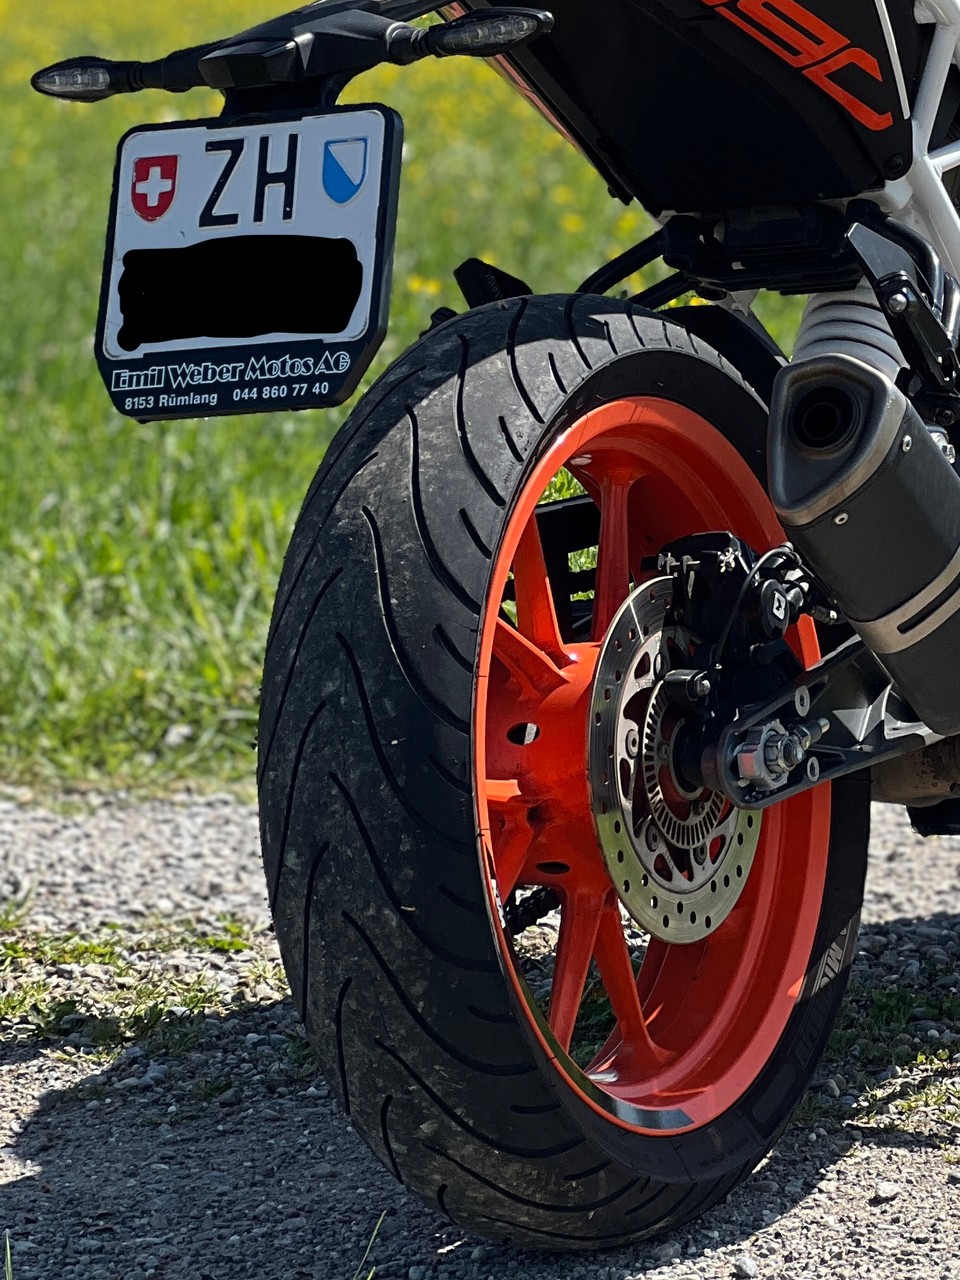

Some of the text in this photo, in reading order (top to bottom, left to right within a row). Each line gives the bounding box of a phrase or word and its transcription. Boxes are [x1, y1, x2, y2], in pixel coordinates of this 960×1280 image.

[199, 133, 299, 228] ZH
[111, 350, 350, 391] Emil Weber Motos AG
[124, 381, 329, 410] 8153 Rümlang 044 860 77 40
